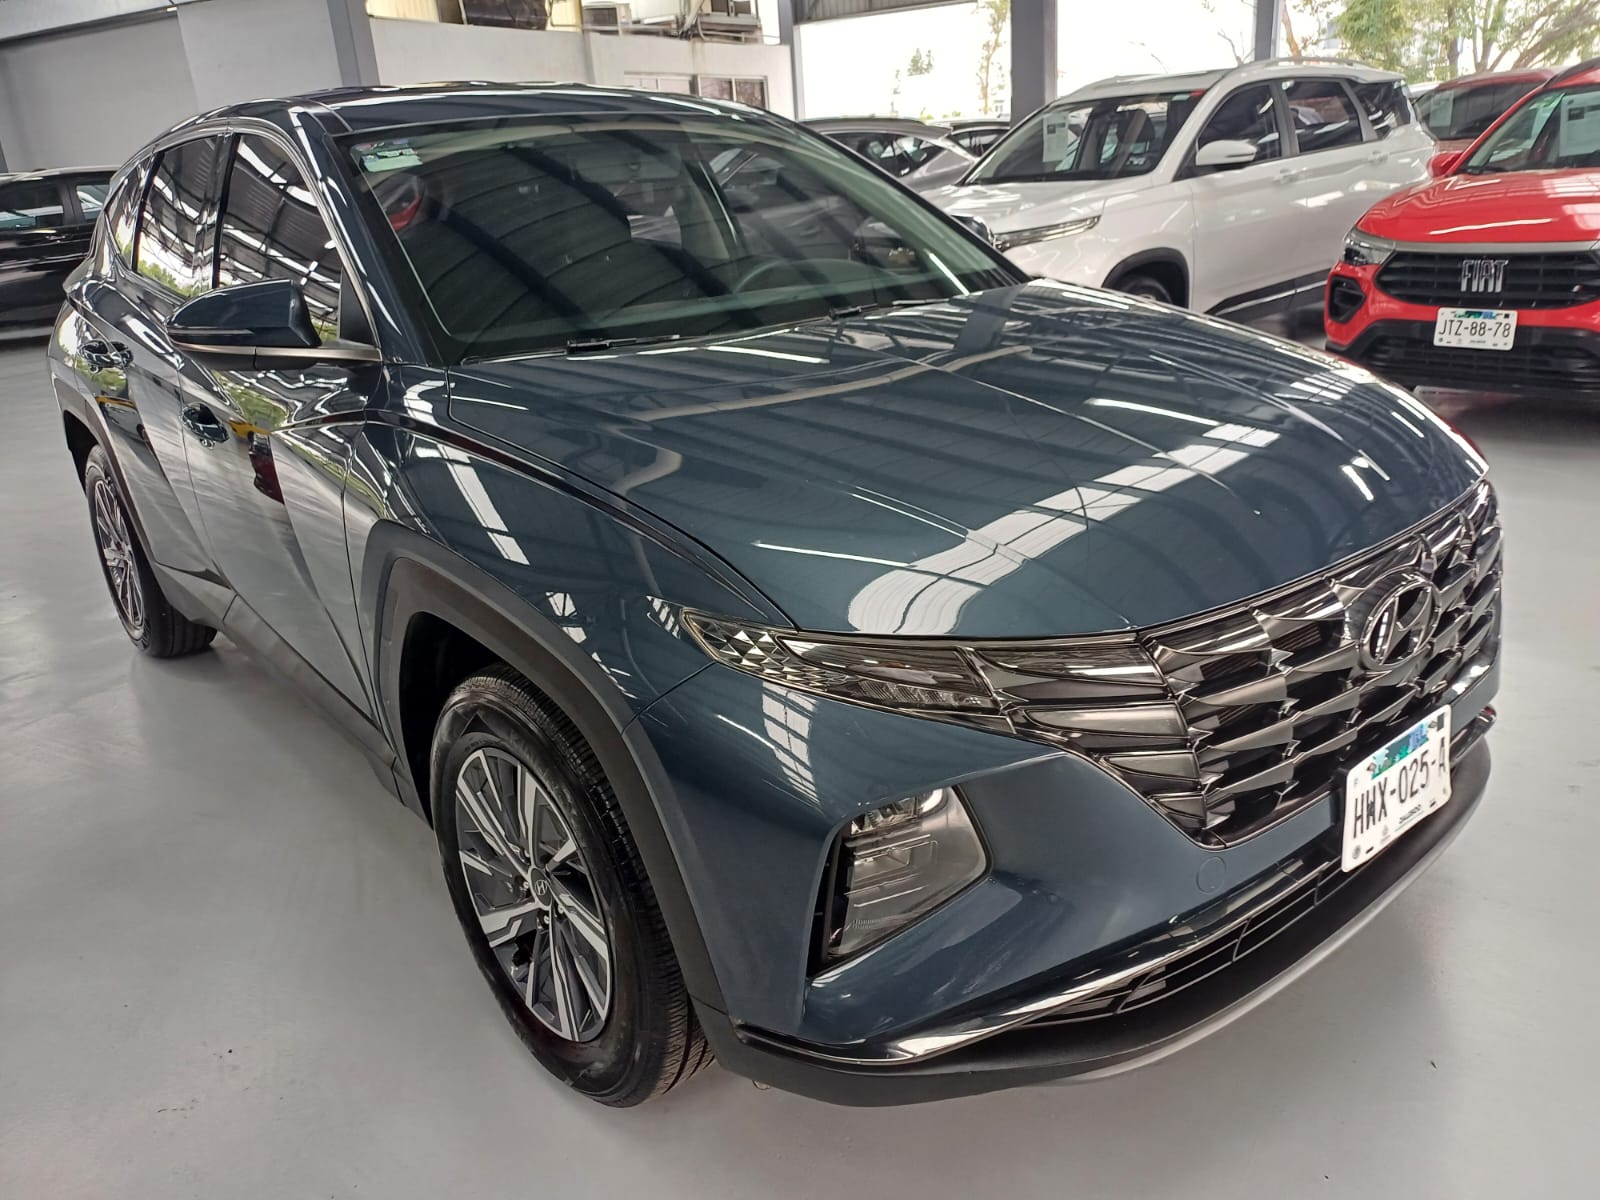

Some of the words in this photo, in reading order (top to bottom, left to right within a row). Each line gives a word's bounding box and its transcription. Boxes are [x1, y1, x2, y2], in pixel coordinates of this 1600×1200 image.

[1461, 259, 1508, 293] FIAT
[1438, 319, 1511, 338] JTZ-88-78
[1353, 736, 1446, 839] HWX-025-A
